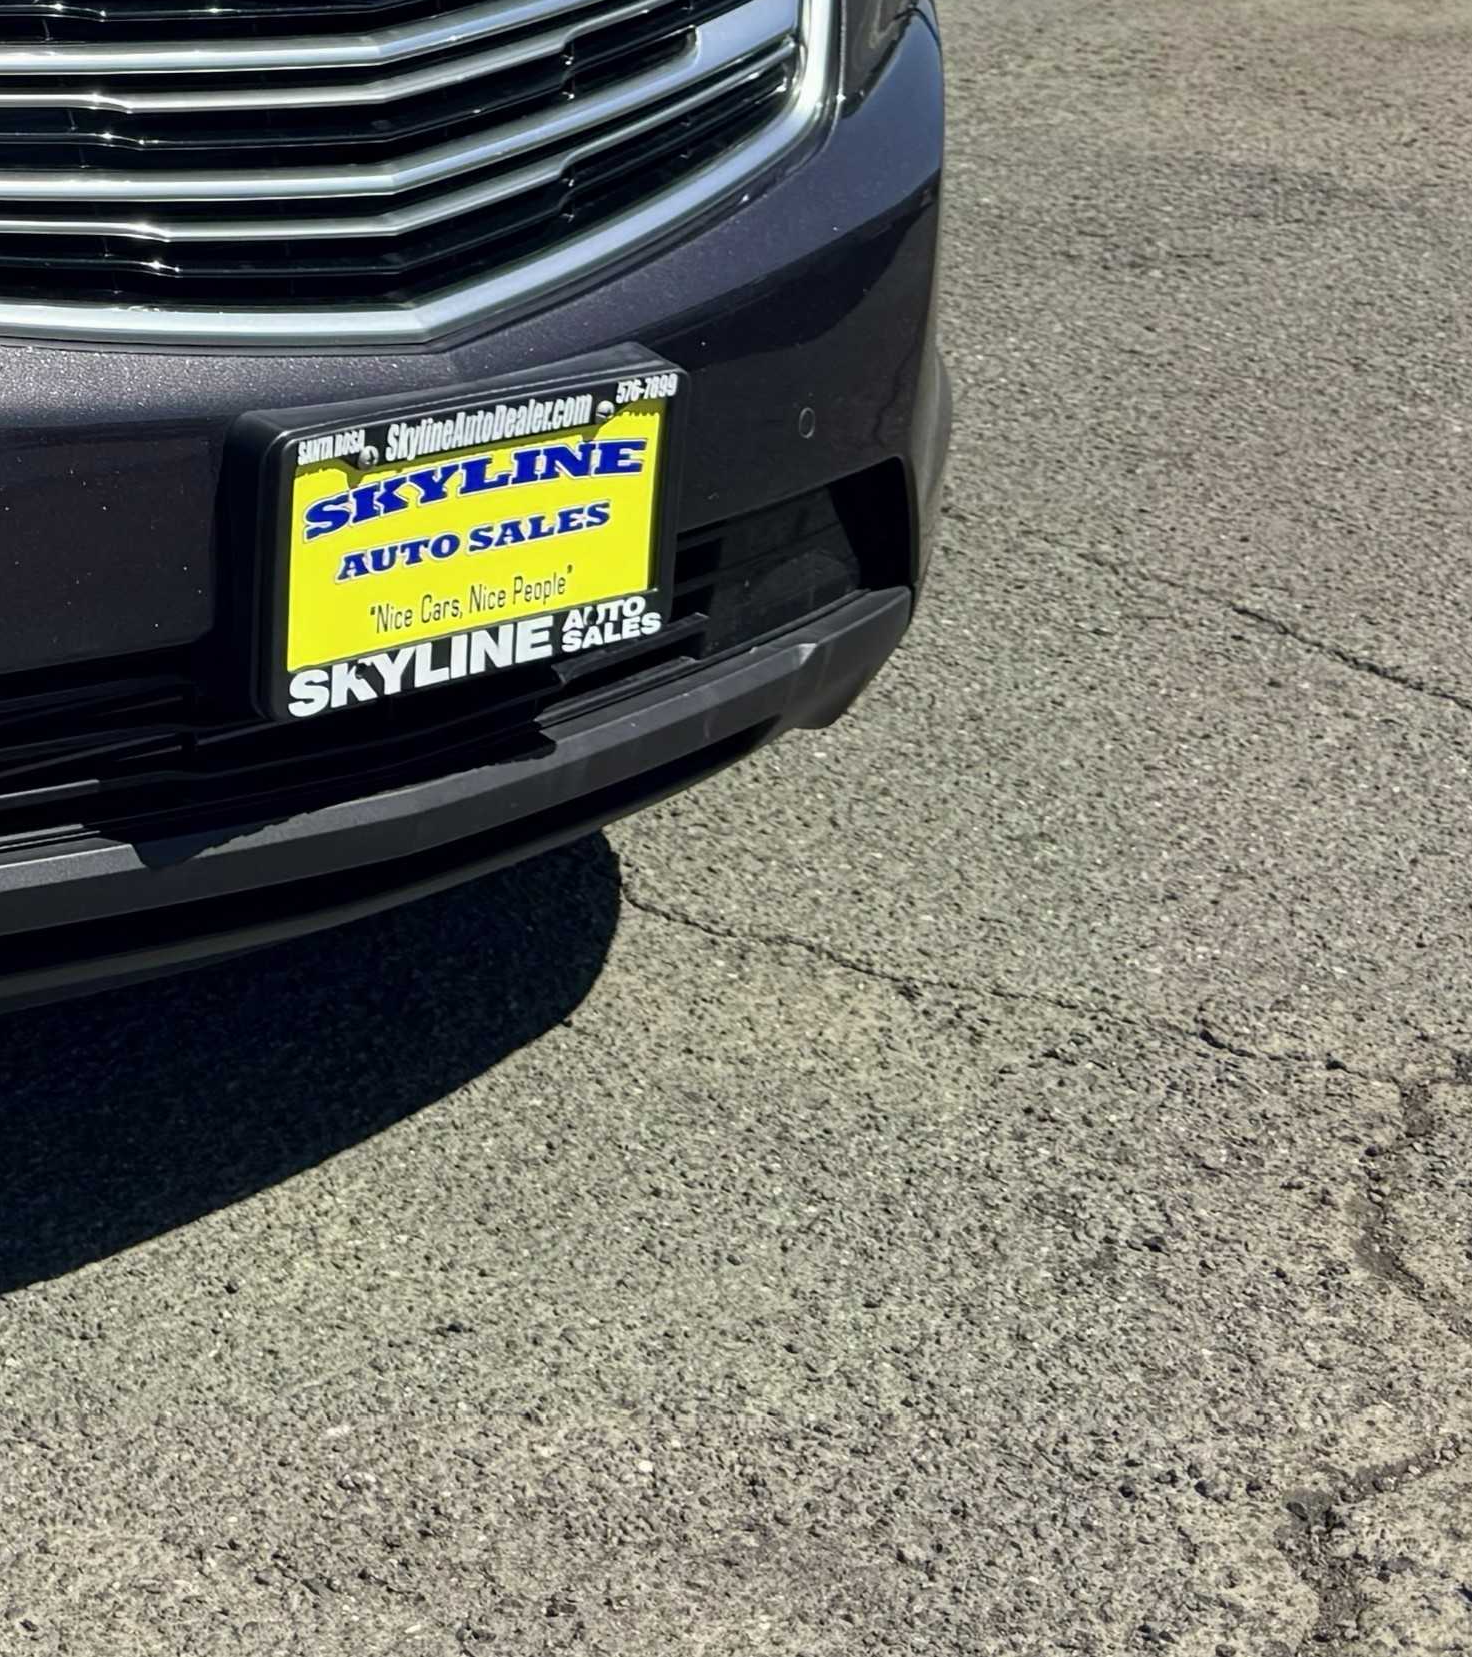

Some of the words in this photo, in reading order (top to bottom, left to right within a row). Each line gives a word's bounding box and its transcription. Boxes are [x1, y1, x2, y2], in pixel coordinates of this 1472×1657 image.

[616, 373, 679, 404] 576-7899
[298, 436, 334, 465] SANTA
[385, 393, 594, 462] SkylineAutoDealer.com
[303, 437, 648, 543] SKYLINE
[335, 531, 461, 584] AUTO
[466, 499, 613, 554] SALES
[369, 602, 413, 633] "Nice
[421, 594, 464, 624] Cars,
[468, 584, 506, 614] Nice
[561, 611, 662, 653] SALES
[562, 596, 647, 633] AUTO
[288, 616, 554, 719] SKYLINE
